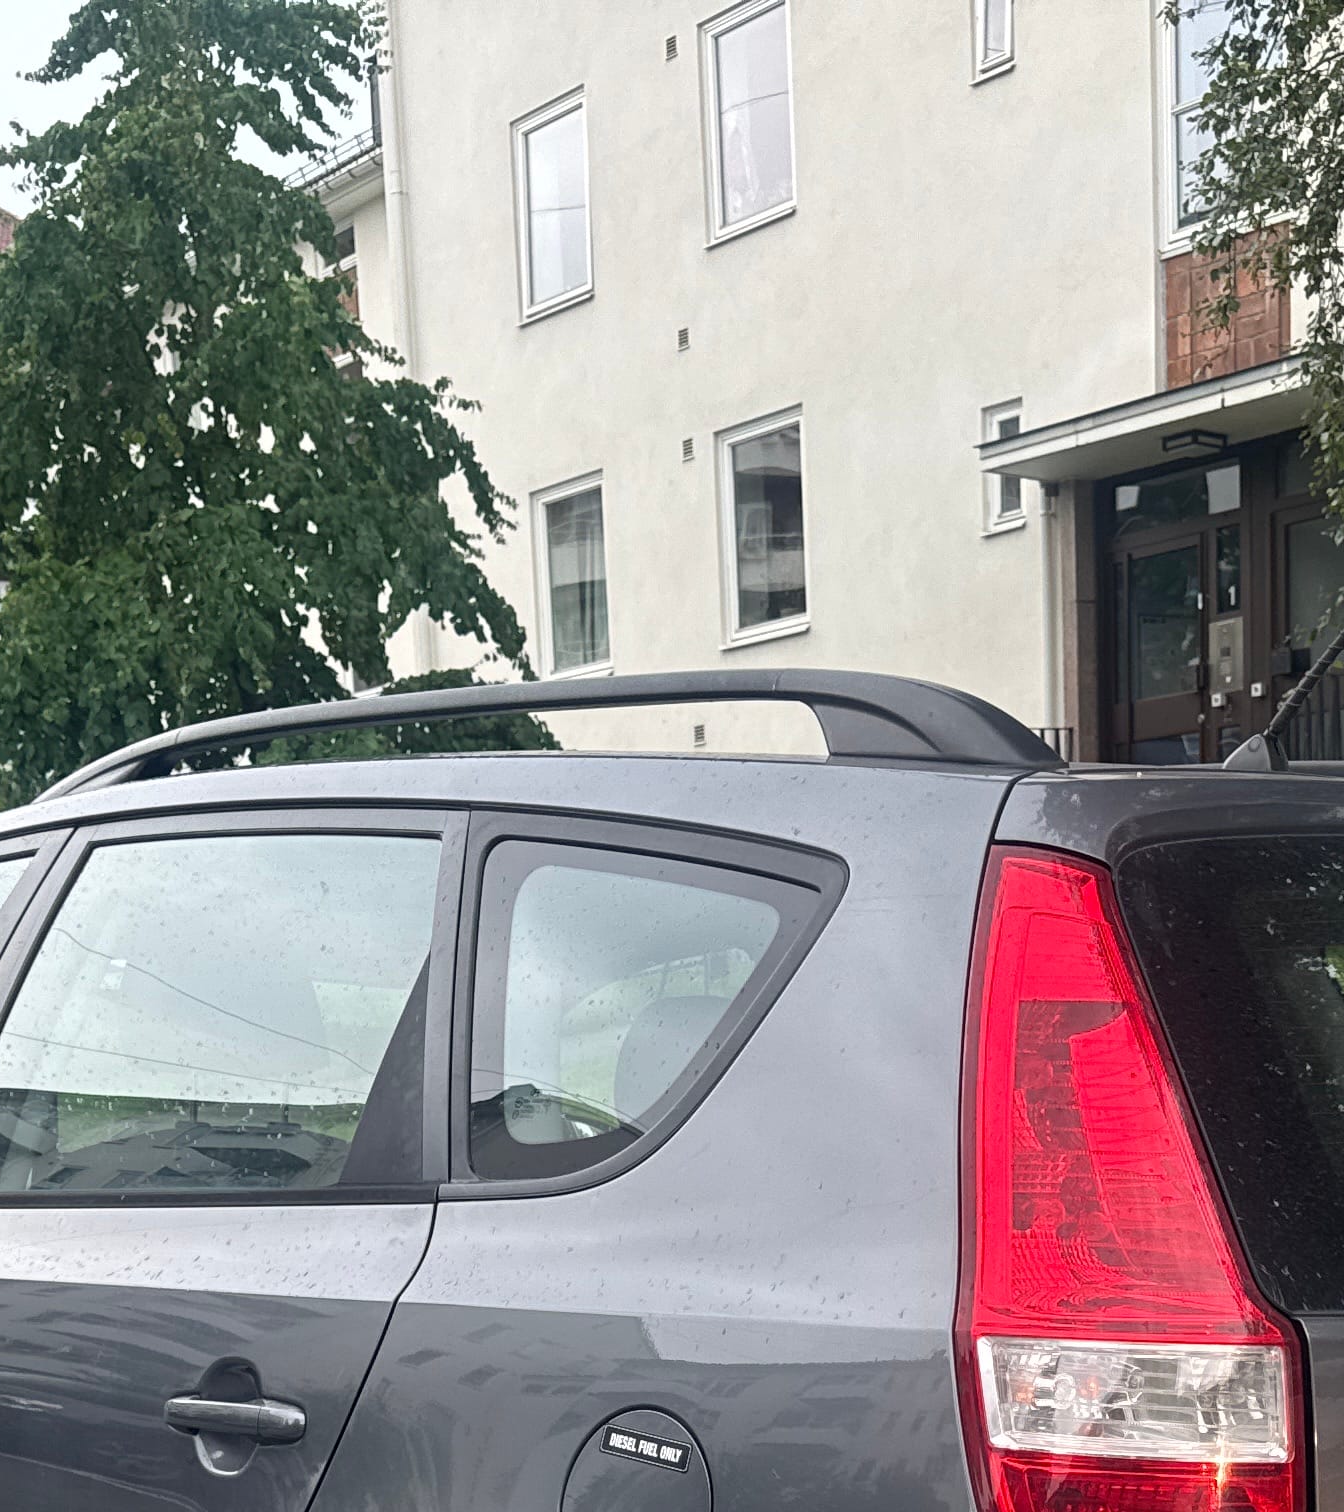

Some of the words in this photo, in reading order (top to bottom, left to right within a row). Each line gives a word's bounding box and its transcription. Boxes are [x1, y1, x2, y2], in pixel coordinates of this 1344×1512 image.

[1228, 585, 1236, 606] 1
[609, 1432, 637, 1453] DIESEL
[637, 1439, 659, 1457] FUEL
[659, 1445, 682, 1463] ONLY
